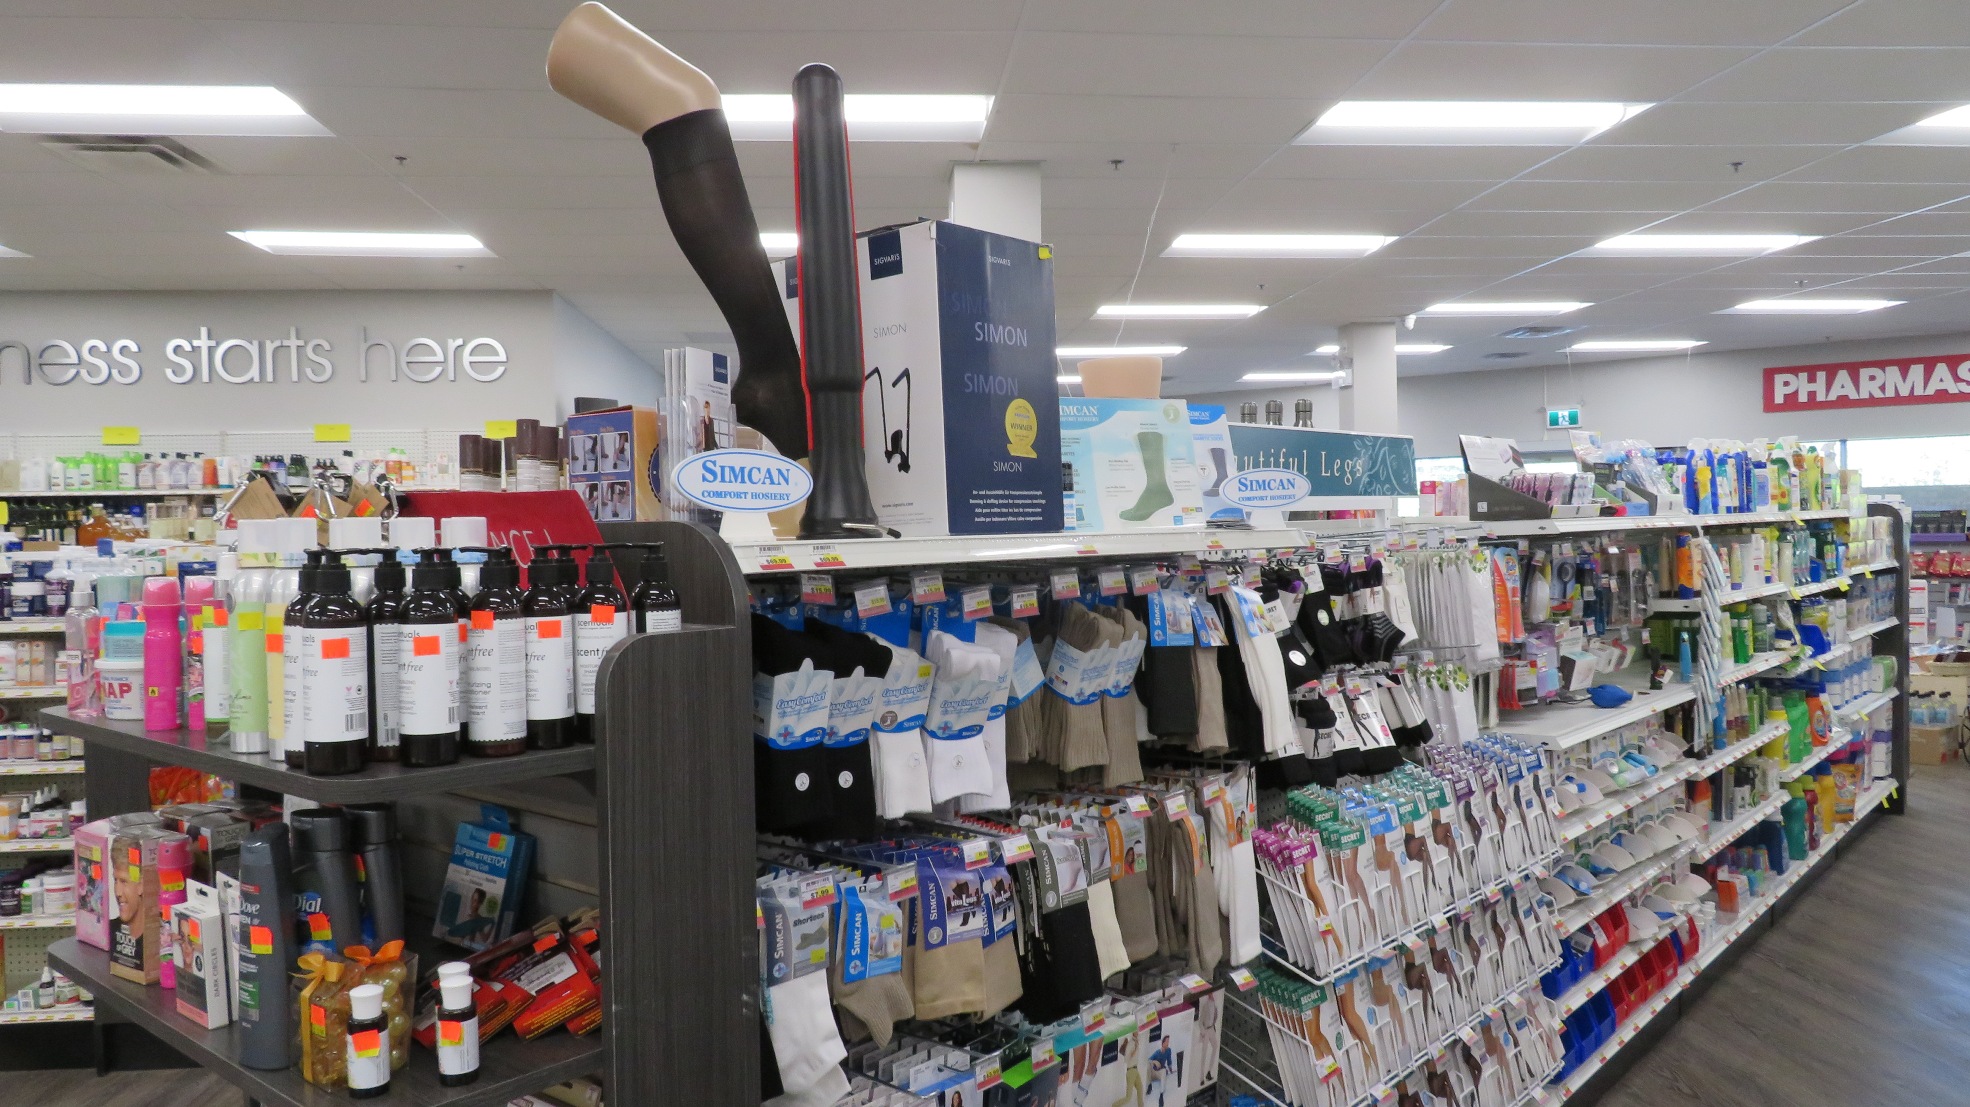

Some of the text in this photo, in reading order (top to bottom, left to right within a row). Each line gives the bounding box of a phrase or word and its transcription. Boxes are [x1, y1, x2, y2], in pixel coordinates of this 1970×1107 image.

[873, 253, 900, 266] SIGVARIS
[988, 255, 1011, 267] SIGVARIS
[873, 322, 907, 338] SIMON
[974, 321, 1028, 347] SIMON
[164, 326, 334, 385] starts
[359, 325, 508, 384] here
[964, 372, 1019, 397] SIMON
[1060, 405, 1098, 416] IMCAN
[1010, 423, 1033, 433] WINNER
[701, 459, 791, 487] SIMCAN
[993, 461, 1022, 473] SIMON
[1320, 451, 1363, 486] Legs
[1238, 477, 1296, 492] SIMCAN
[701, 490, 791, 502] COMFORT HOSIERY
[1269, 493, 1296, 501] HOSIERY
[474, 644, 494, 661] free
[528, 652, 546, 663] free
[576, 647, 600, 657] scent
[405, 661, 424, 674] free
[1315, 811, 1334, 822] SECRET
[1369, 814, 1386, 825] SECRET
[1340, 832, 1360, 844] SECRET
[454, 844, 507, 869] SUPER STRETCH
[1292, 845, 1311, 859] SECRET
[1042, 849, 1052, 885] SIMCAN
[810, 888, 829, 899] $7.99
[930, 884, 938, 921] SIMCAN
[792, 912, 825, 928] Shortees
[115, 930, 136, 947] TOUCH
[774, 914, 784, 959] SIMCAN
[851, 912, 862, 956] SIMCAN
[121, 944, 137, 957] GREY
[211, 947, 219, 977] CIRCLES
[1301, 989, 1321, 1005] SECRET
